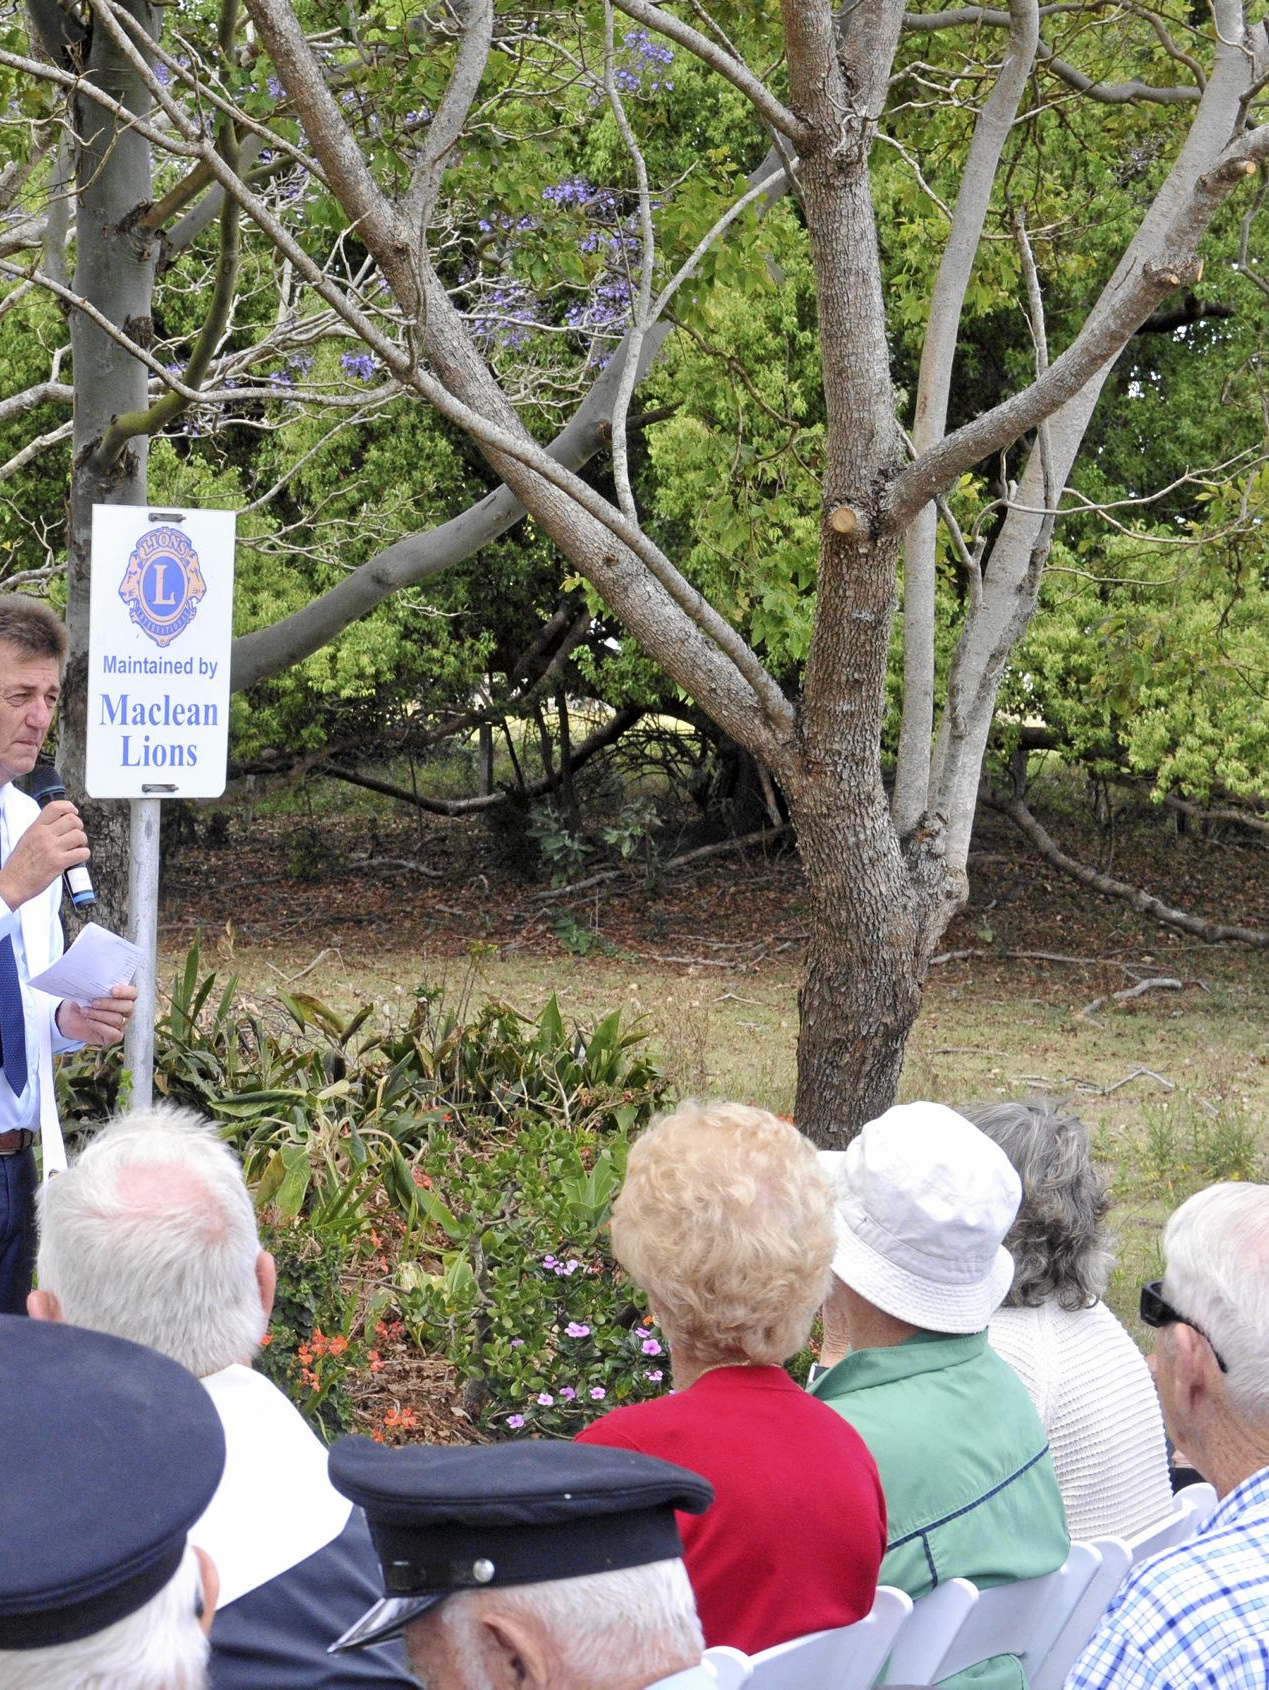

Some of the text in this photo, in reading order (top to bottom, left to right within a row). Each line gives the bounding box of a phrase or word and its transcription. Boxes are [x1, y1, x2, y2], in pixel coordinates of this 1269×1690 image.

[141, 531, 187, 556] LIONS
[152, 564, 176, 605] L
[103, 655, 218, 680] Maintained by
[99, 693, 219, 727] Maclean
[119, 735, 198, 767] Lions
